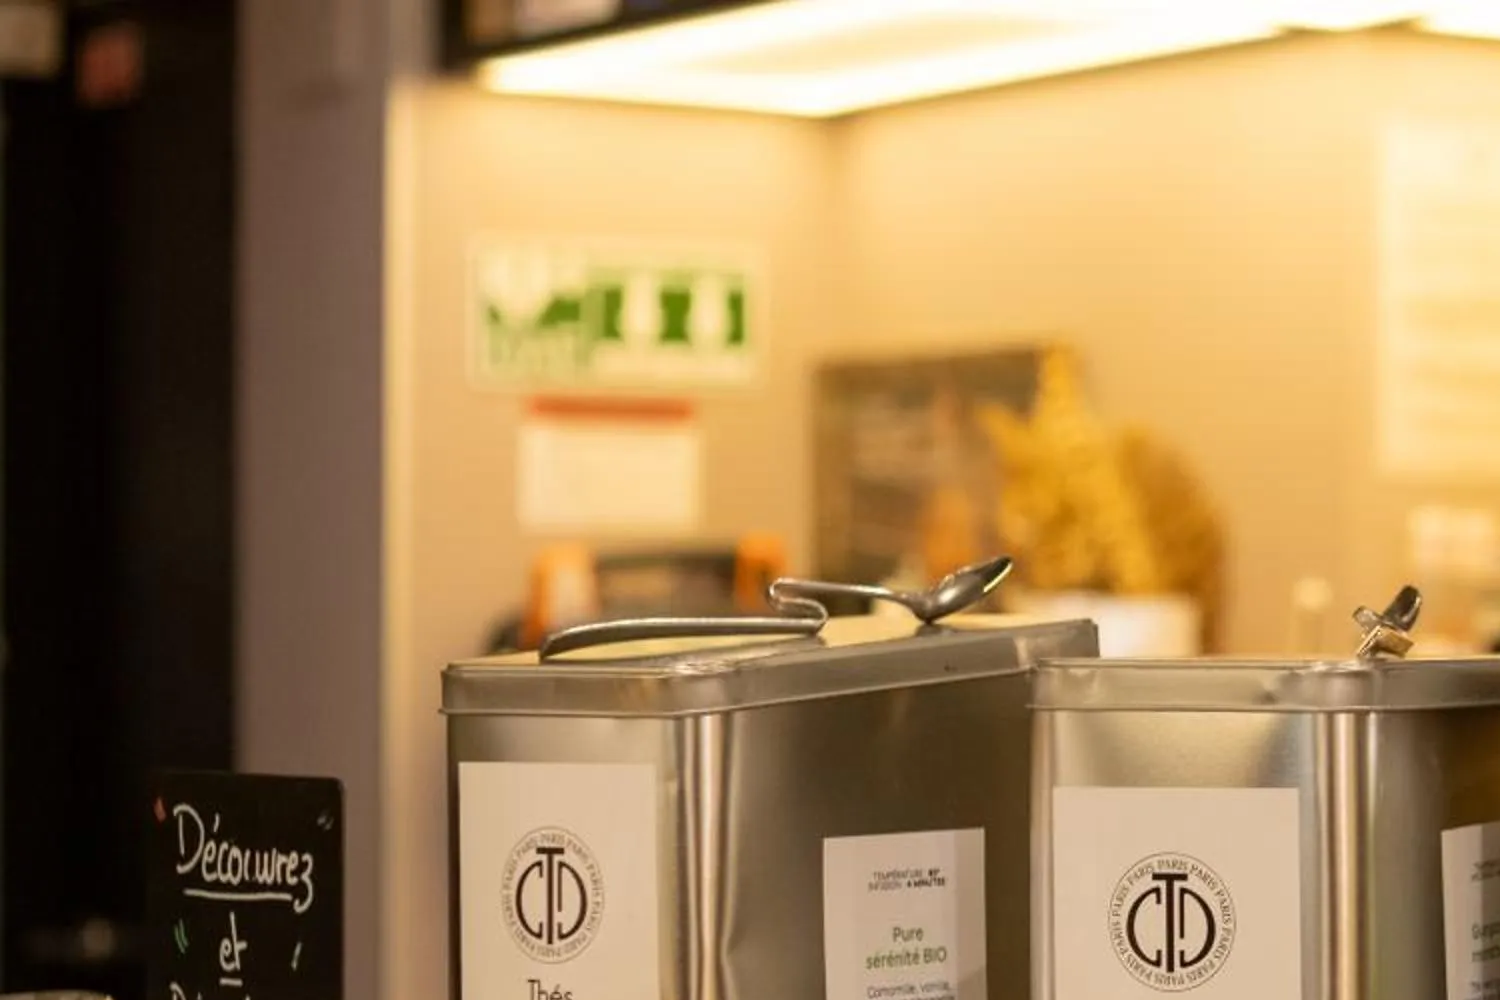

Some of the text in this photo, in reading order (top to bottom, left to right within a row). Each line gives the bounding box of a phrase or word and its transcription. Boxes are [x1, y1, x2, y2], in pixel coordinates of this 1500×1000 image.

[173, 803, 314, 913] Découvrez
[220, 911, 247, 971] et
[892, 926, 924, 943] Pure
[923, 946, 947, 965] BIO
